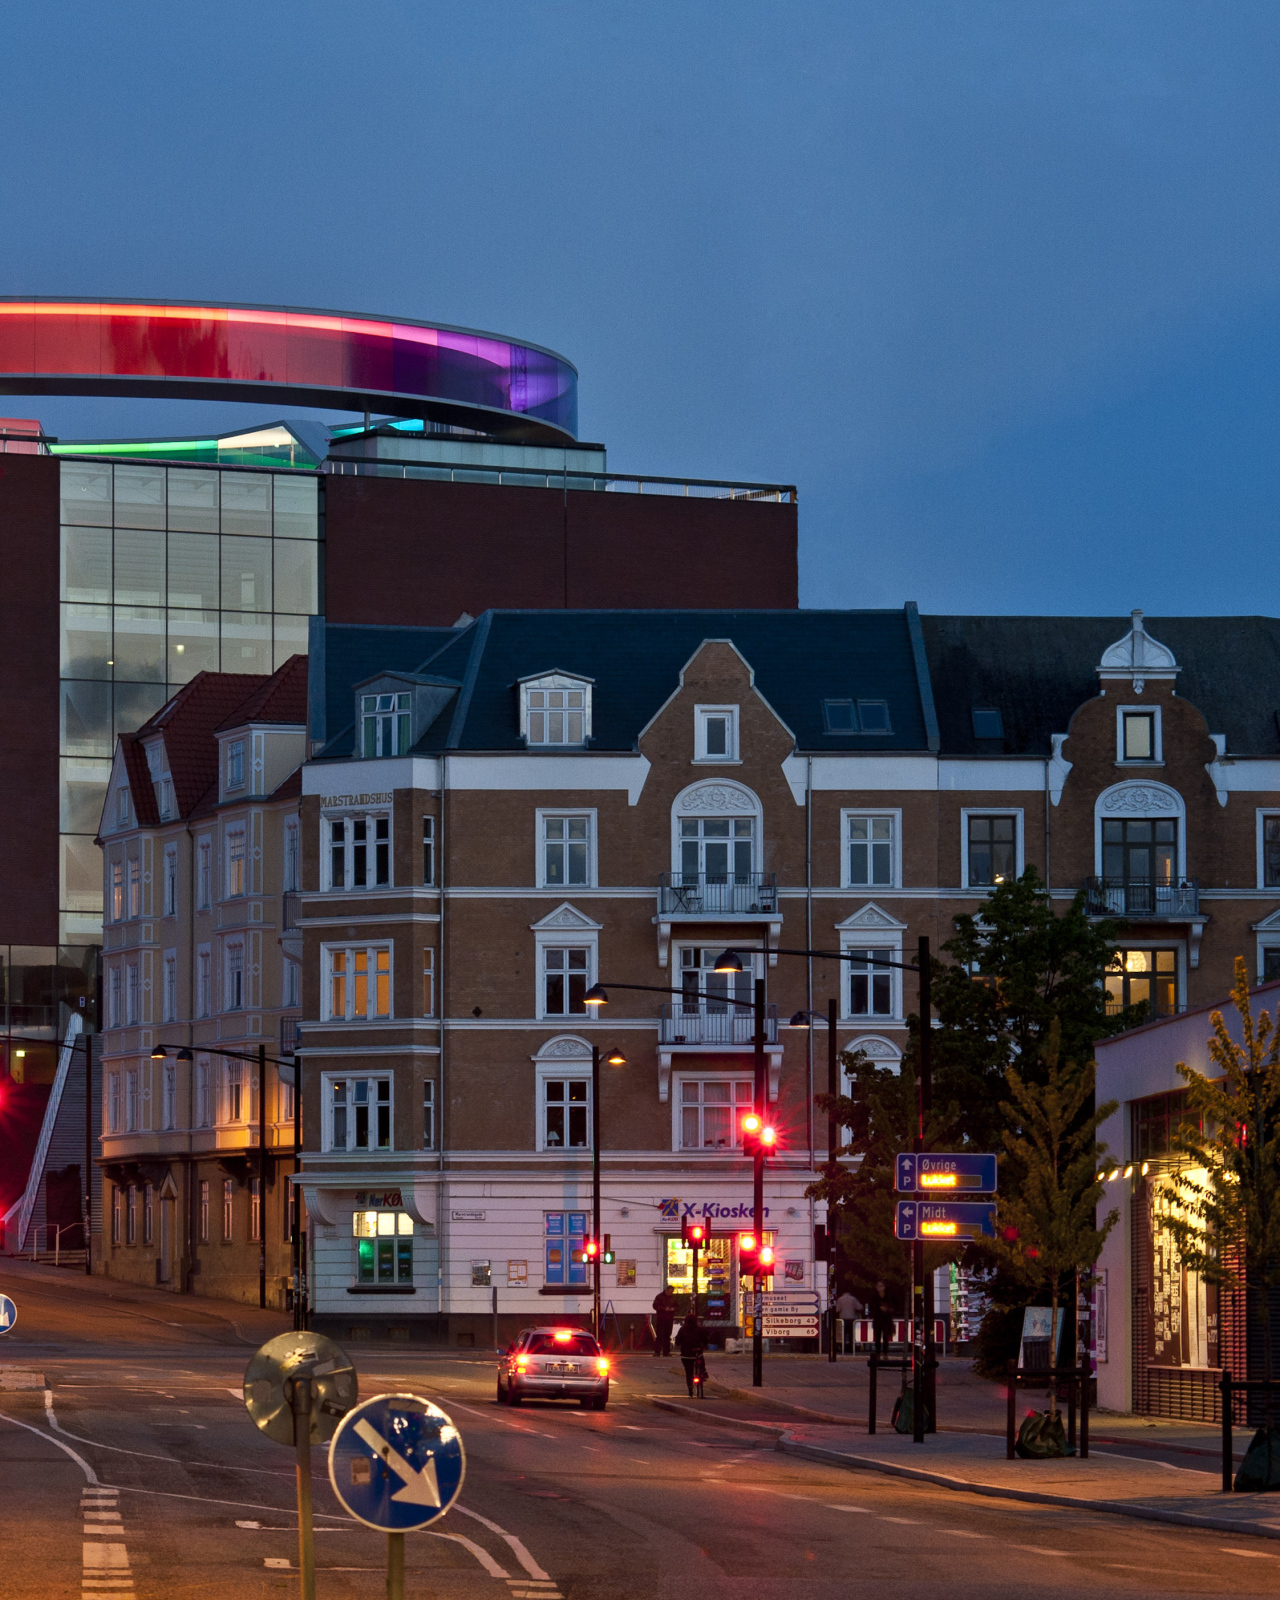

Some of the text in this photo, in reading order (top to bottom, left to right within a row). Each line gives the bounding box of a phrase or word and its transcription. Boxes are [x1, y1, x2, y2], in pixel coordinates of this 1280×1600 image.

[320, 792, 393, 807] MARSTRANDSHUS
[922, 1159, 956, 1172] Øvrige
[903, 1176, 911, 1186] P
[921, 1174, 956, 1186] Lukket
[922, 1206, 946, 1219] Midt
[903, 1224, 911, 1234] P
[921, 1222, 956, 1235] Lukket
[766, 1328, 790, 1336] Viborg
